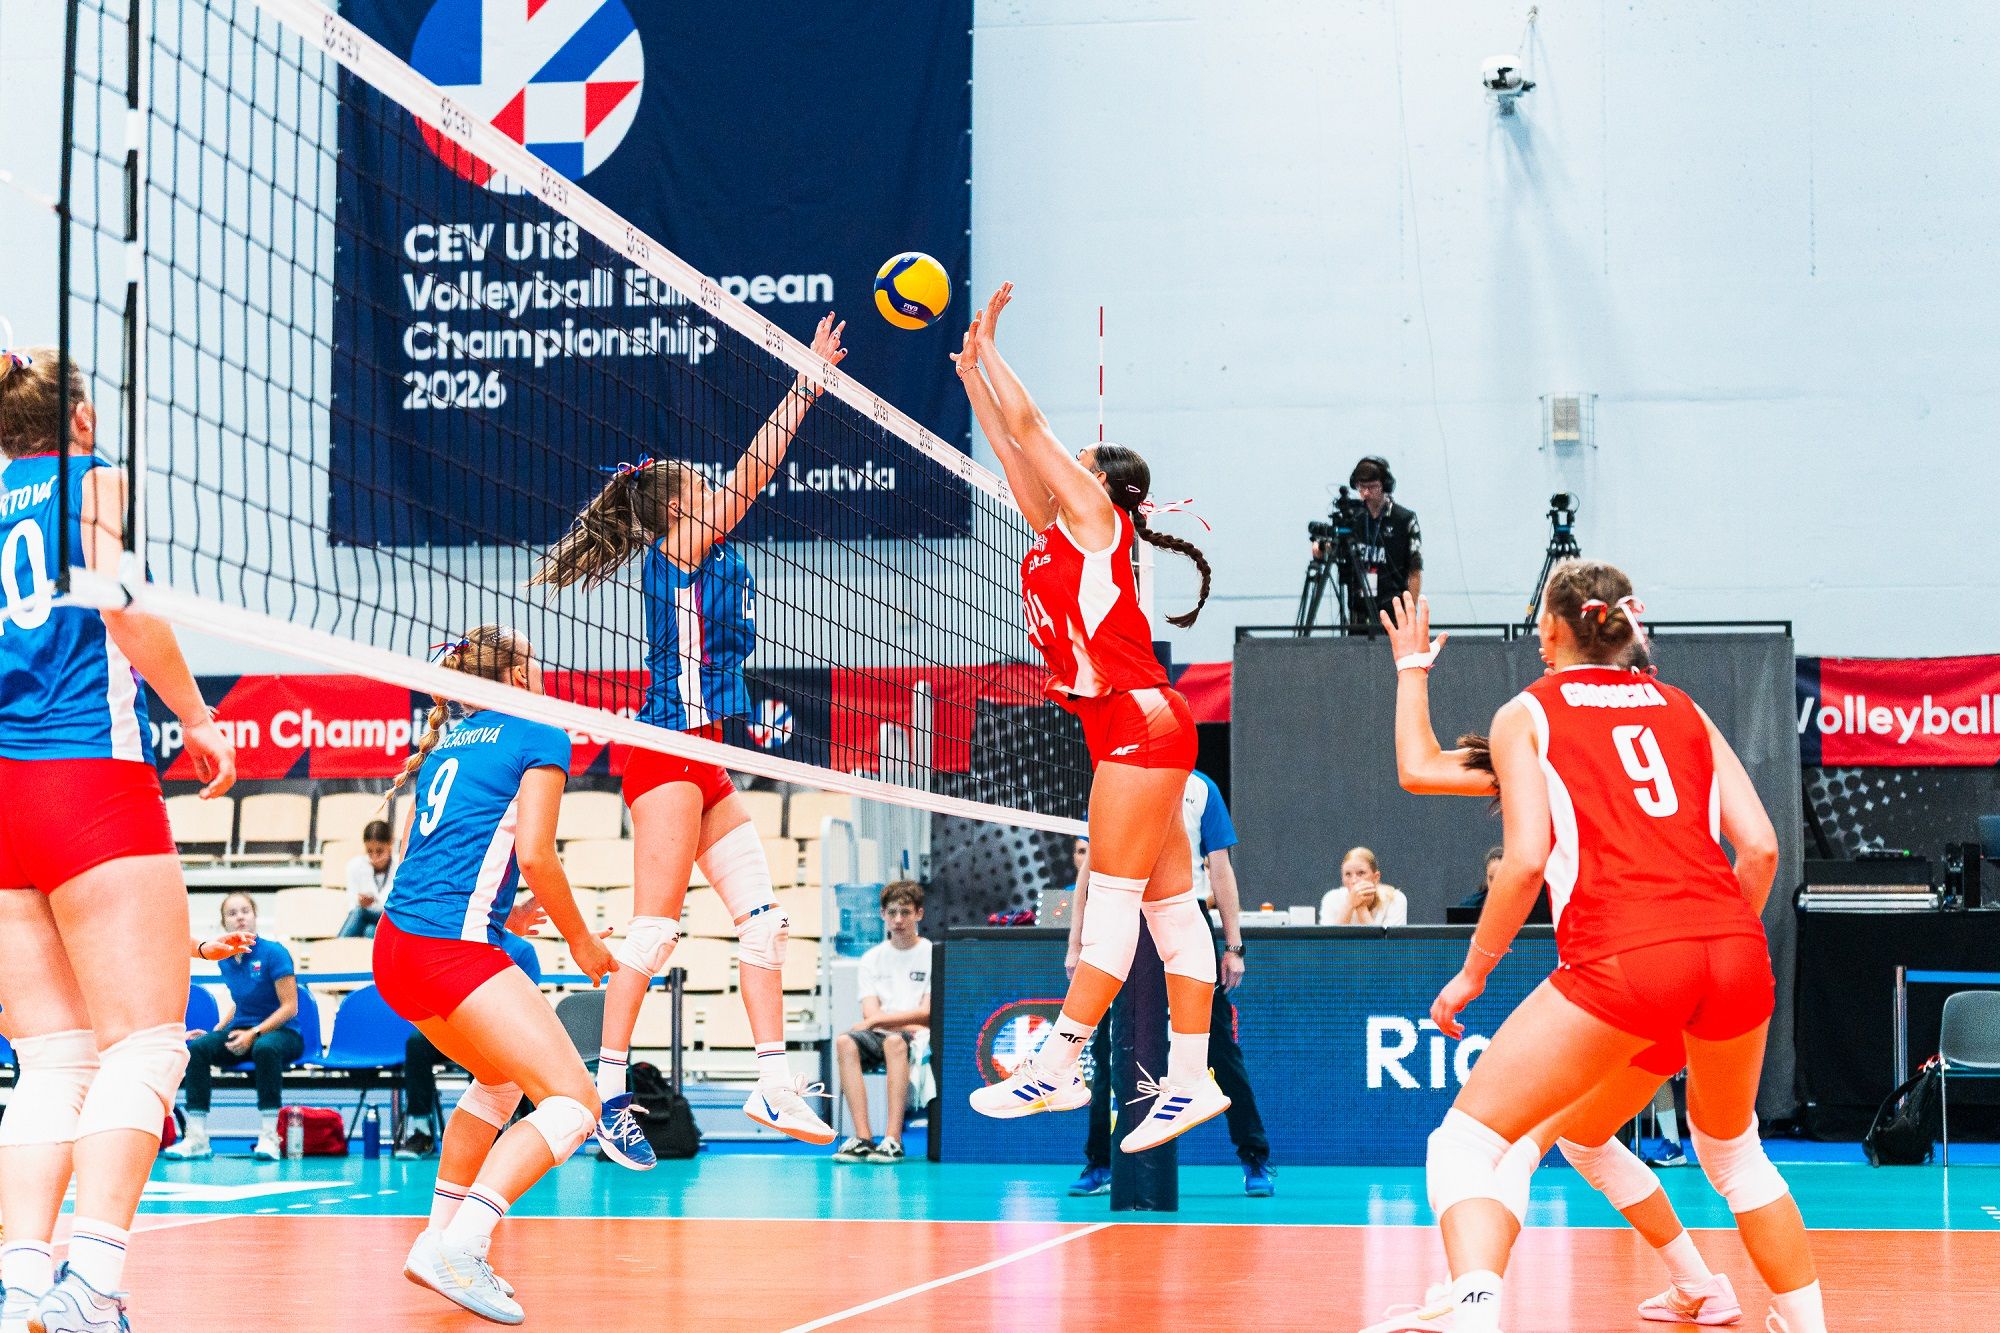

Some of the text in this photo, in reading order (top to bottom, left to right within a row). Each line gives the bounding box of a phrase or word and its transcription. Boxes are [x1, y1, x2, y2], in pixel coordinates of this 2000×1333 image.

[404, 221, 579, 263] CEV U18
[403, 268, 613, 319] Volleyball
[403, 317, 716, 368] Championship
[403, 370, 507, 409] 2026
[788, 460, 895, 491] Latvia
[0, 519, 51, 636] 0
[1028, 553, 1052, 575] plus
[419, 757, 459, 836] 9
[1611, 724, 1679, 818] 9
